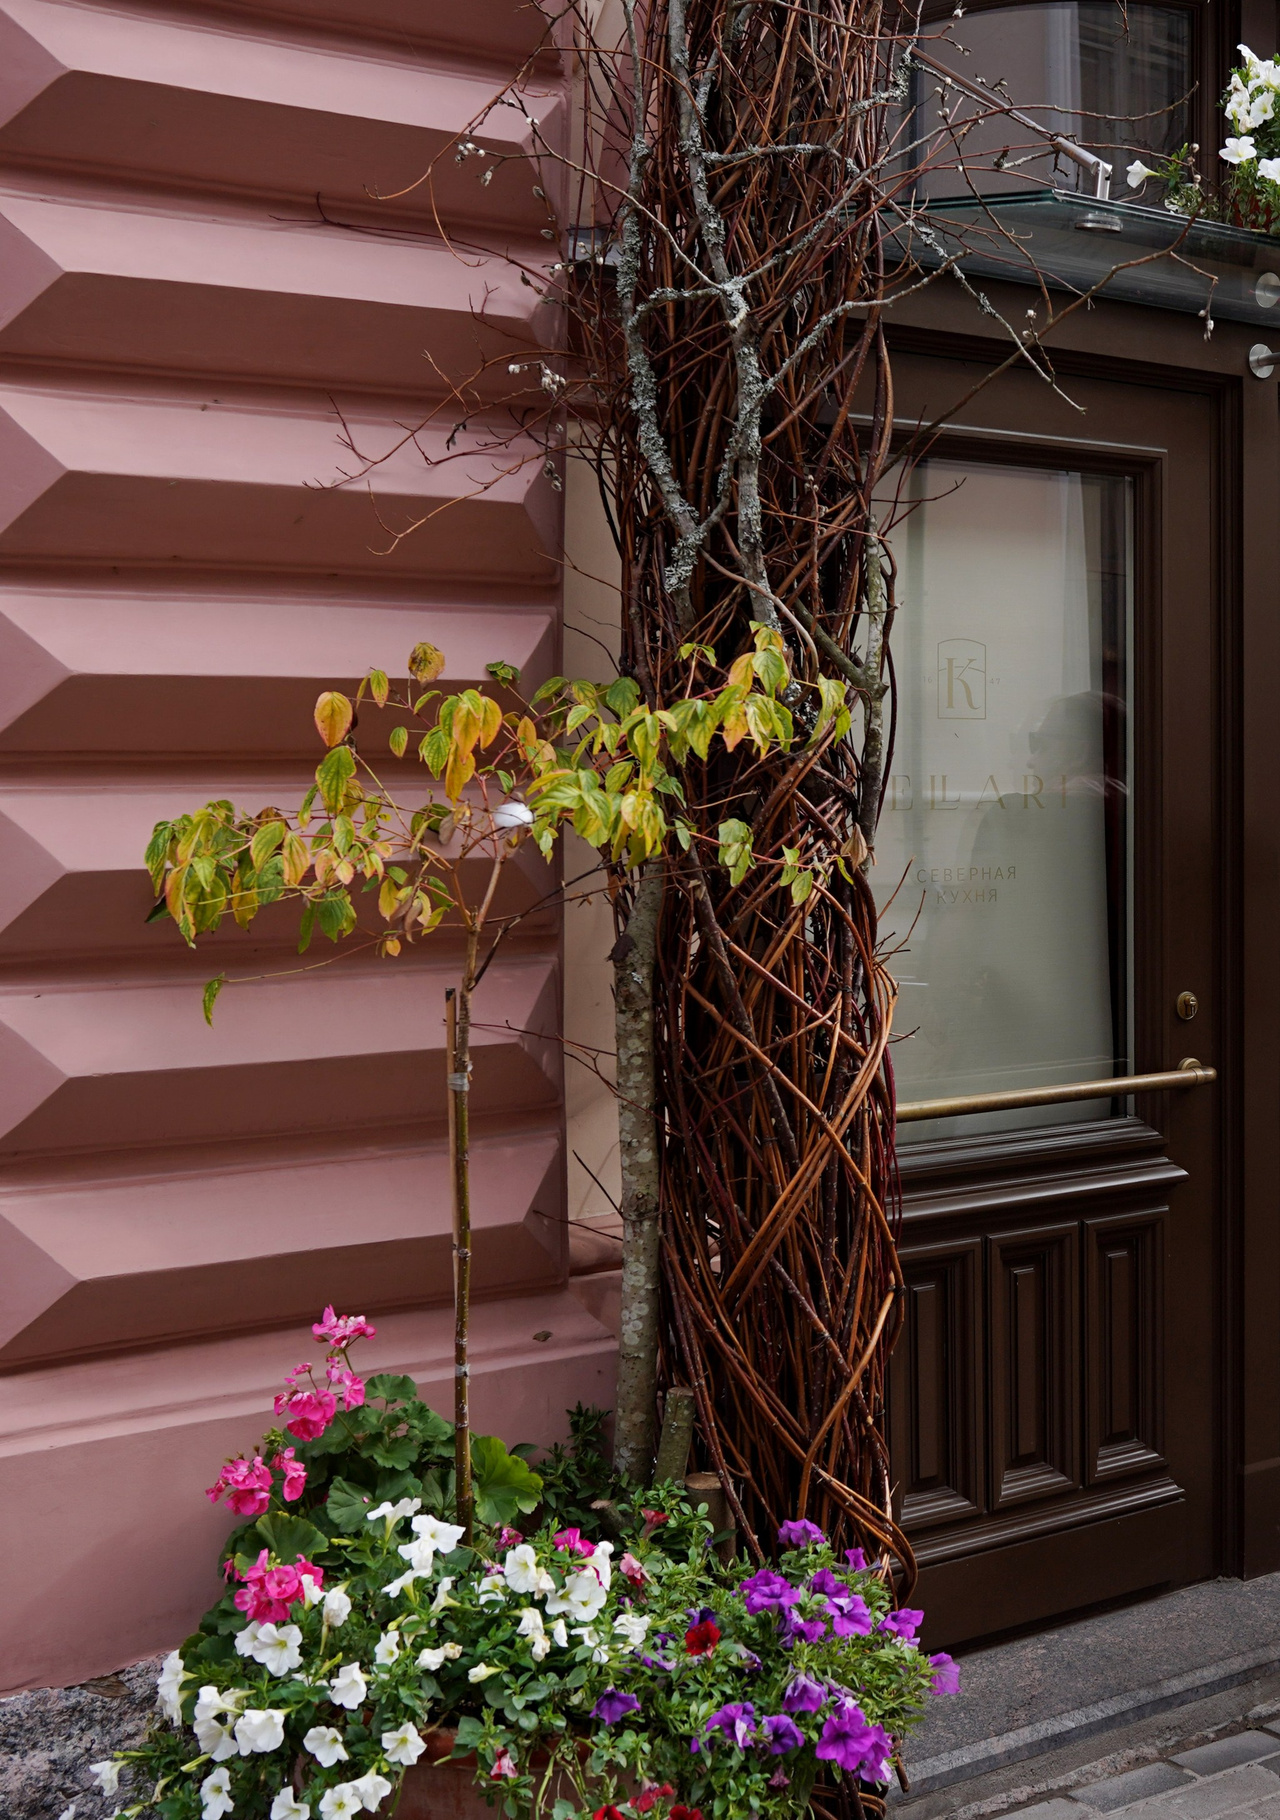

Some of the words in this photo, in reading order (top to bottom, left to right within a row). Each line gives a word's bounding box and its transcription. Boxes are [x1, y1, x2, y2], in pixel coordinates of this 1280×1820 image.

[890, 774, 1067, 812] ELLARI
[916, 865, 1017, 884] СЕВЕРНАЯ
[936, 888, 998, 905] КУХНЯ
